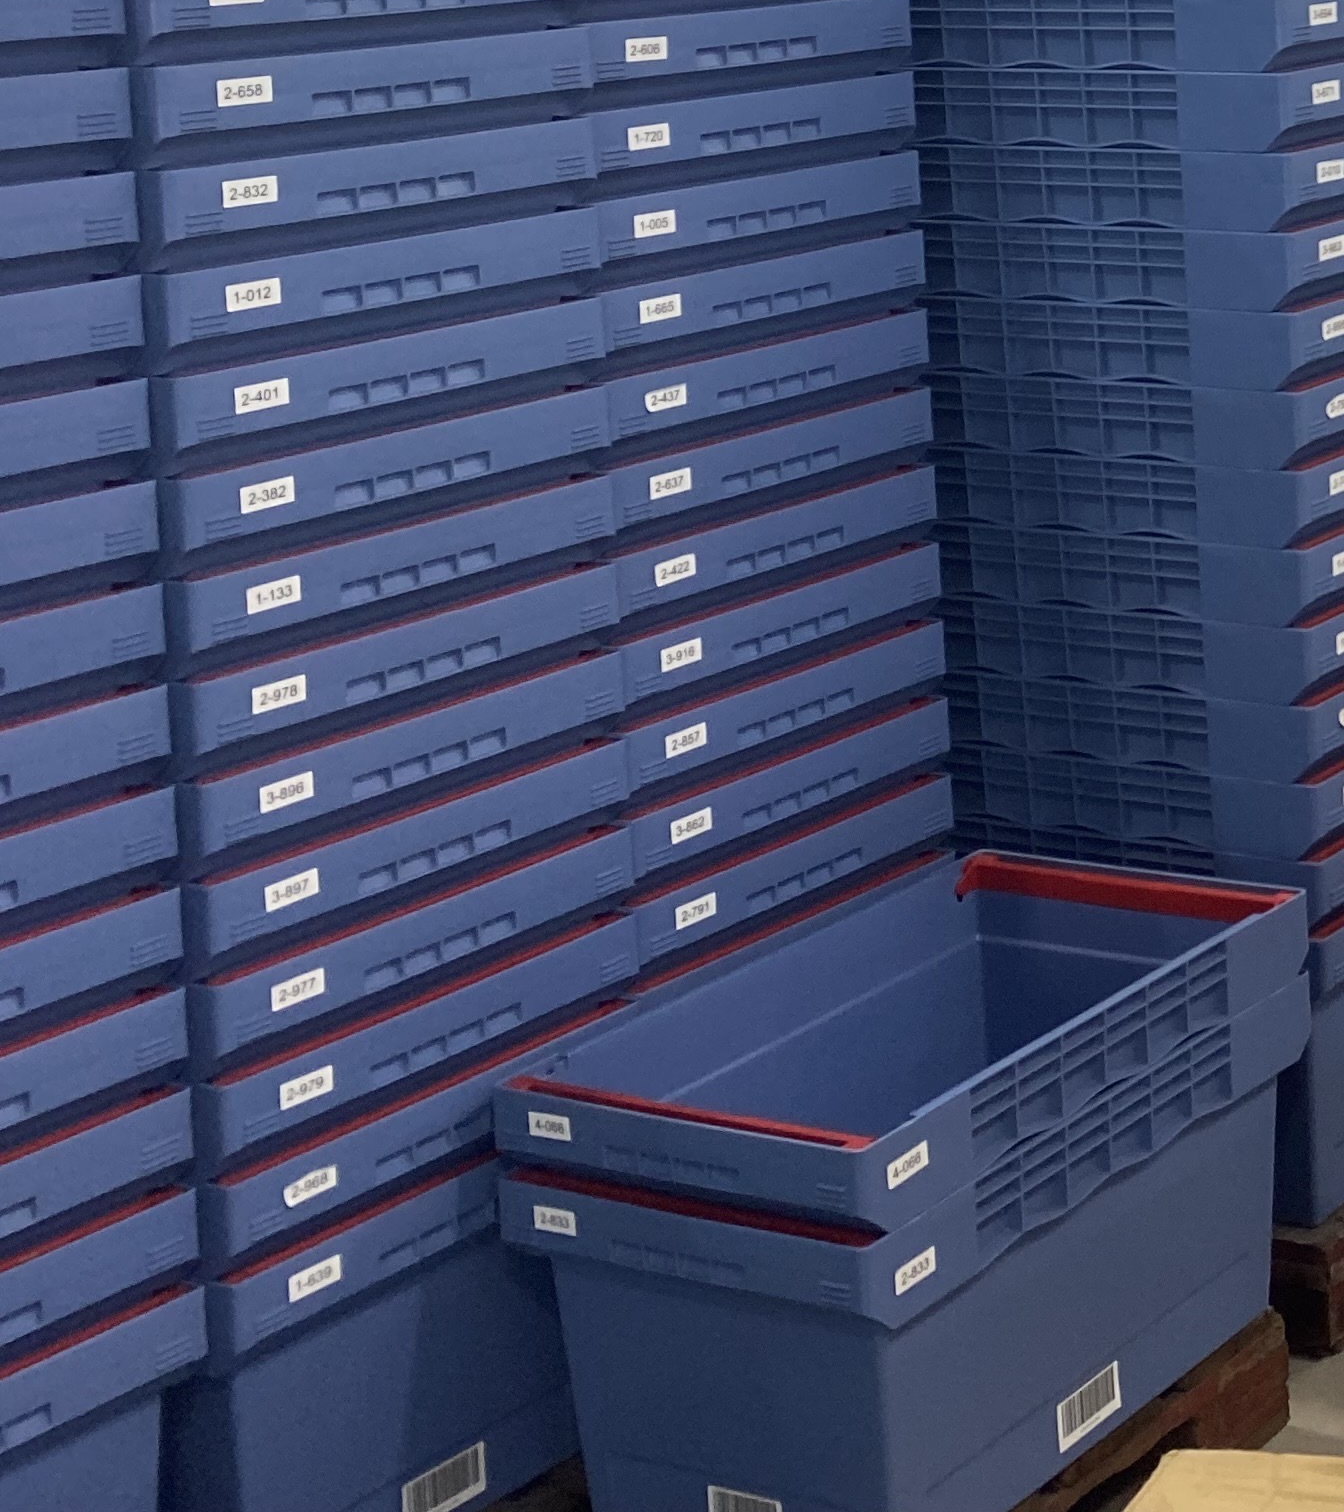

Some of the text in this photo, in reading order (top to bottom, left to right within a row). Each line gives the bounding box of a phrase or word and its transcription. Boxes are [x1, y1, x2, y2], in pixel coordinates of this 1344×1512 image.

[224, 83, 263, 100] 2-658
[634, 130, 663, 143] 1-720
[229, 183, 268, 201] 2-832
[640, 216, 669, 231] 1-005
[234, 286, 271, 304] 1-012
[241, 387, 278, 406] 2-401
[651, 389, 680, 406] 2-437
[655, 475, 684, 493] 2-637
[248, 485, 286, 506] 2-382
[661, 560, 690, 580] 2-422
[256, 584, 293, 605] 1-133
[260, 684, 298, 706] 2-978
[672, 730, 700, 751] 2-857
[267, 781, 304, 805] 3-896
[272, 878, 309, 903] 3-897
[681, 901, 709, 923] 2-791
[279, 977, 316, 1003] 2-977
[286, 1076, 324, 1102] 2-979
[902, 1257, 929, 1286] 2-833
